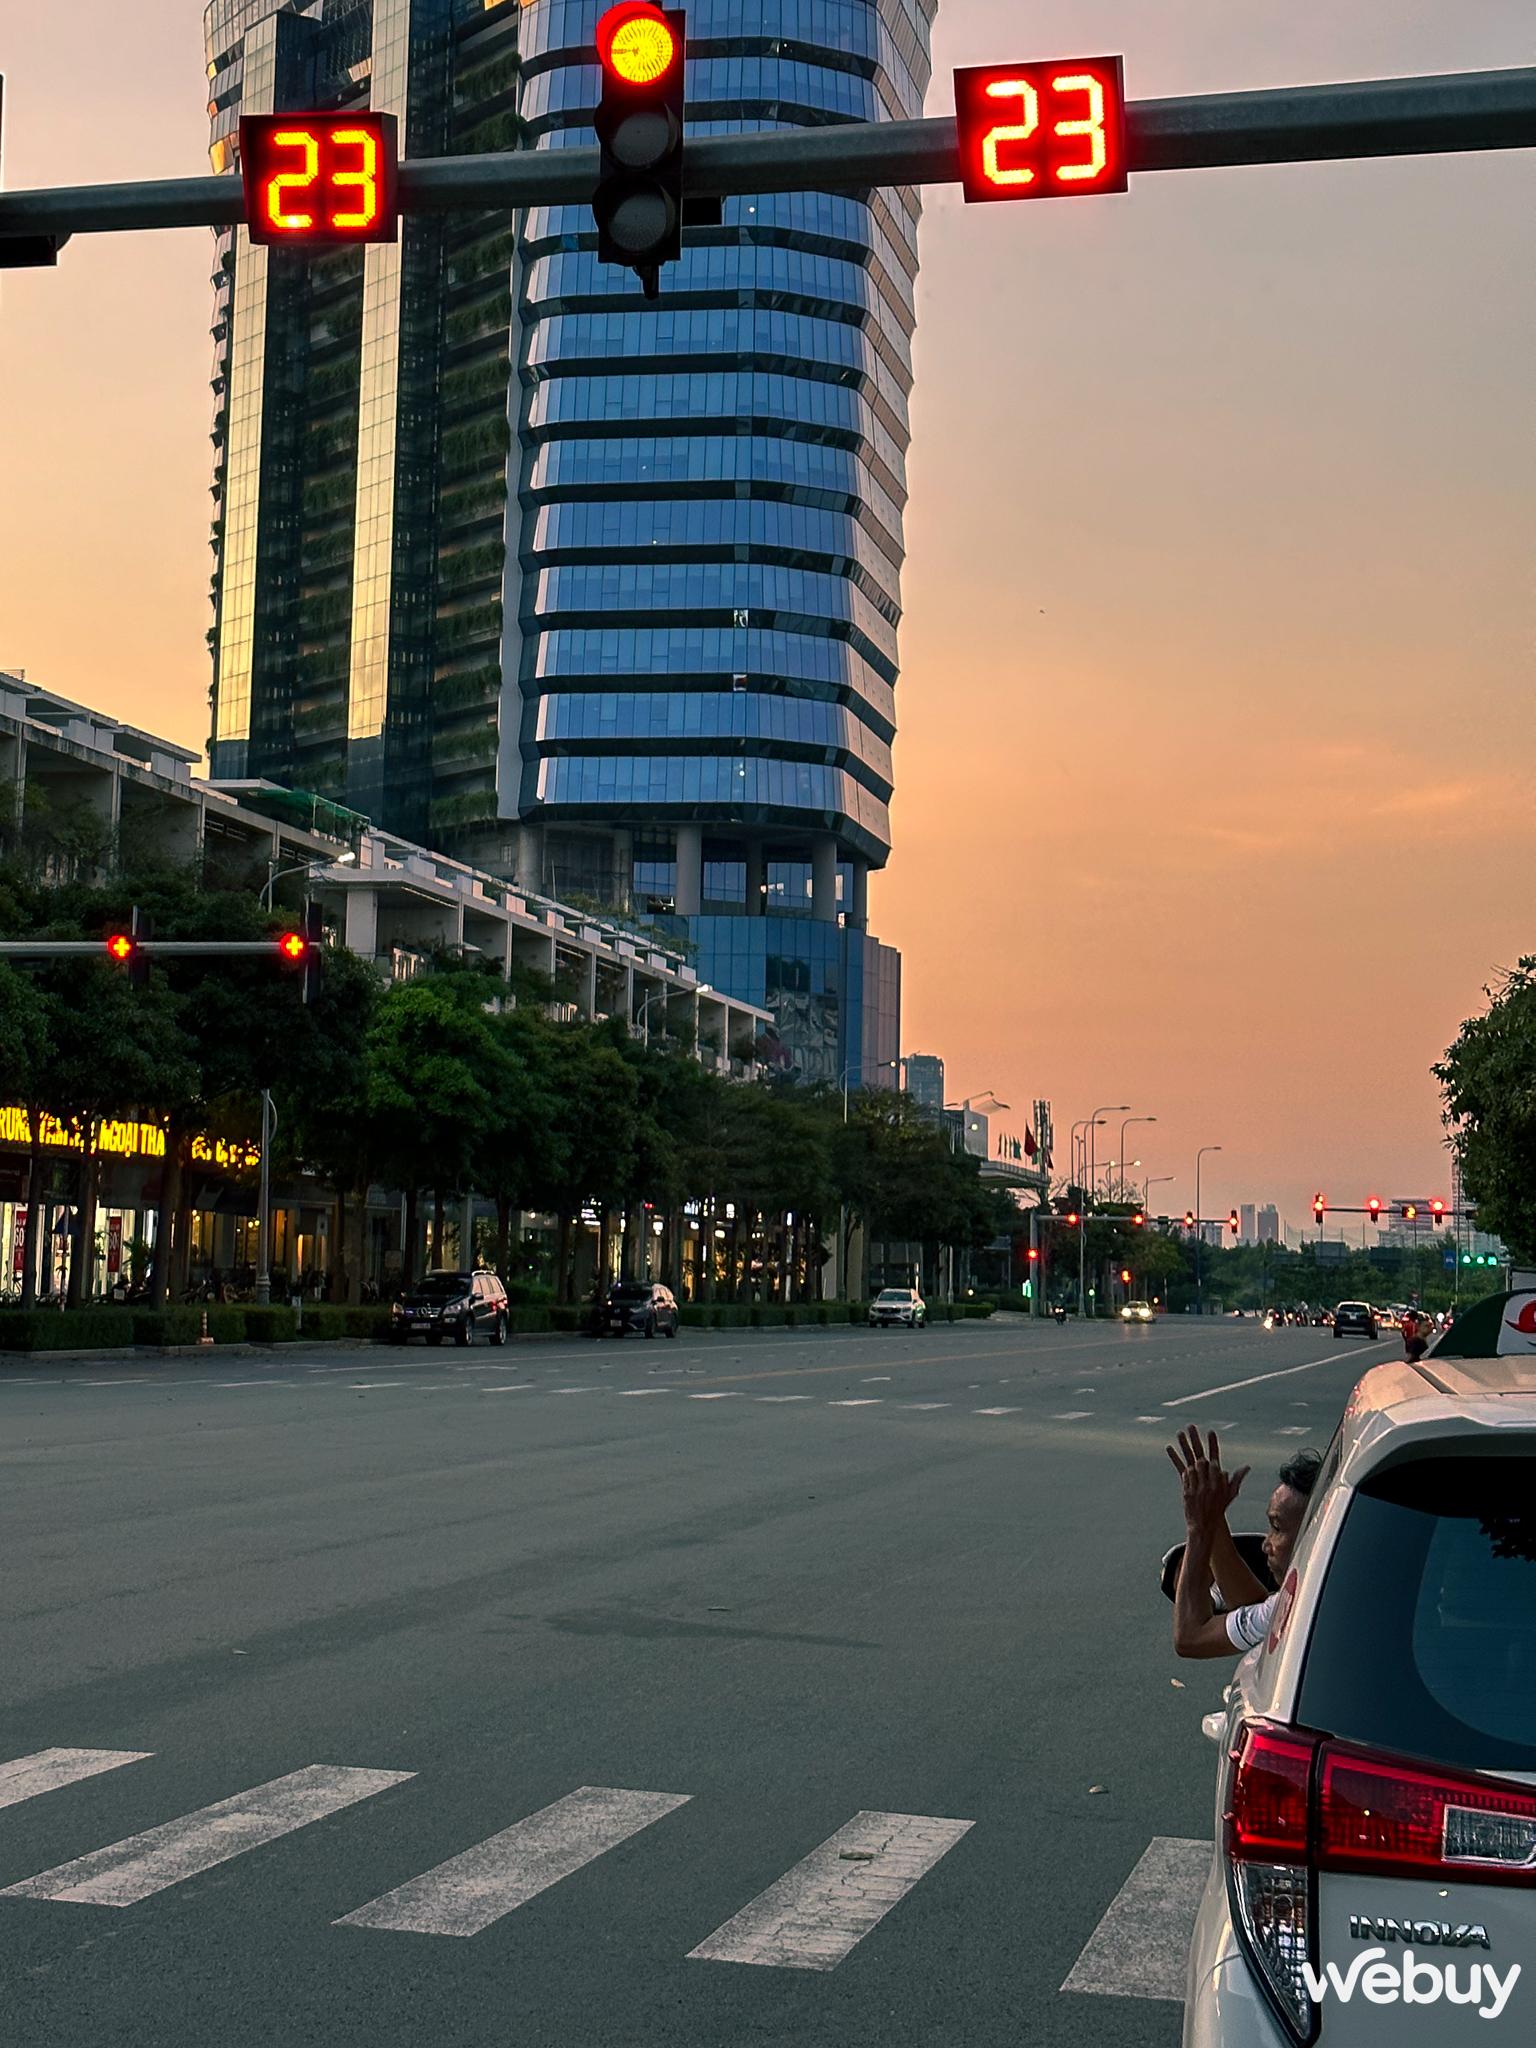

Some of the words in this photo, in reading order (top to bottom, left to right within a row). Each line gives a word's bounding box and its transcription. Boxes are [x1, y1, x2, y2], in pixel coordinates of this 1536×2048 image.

[983, 75, 1106, 184] 23
[268, 130, 376, 228] 23
[1350, 1915, 1491, 1949] INNOVA
